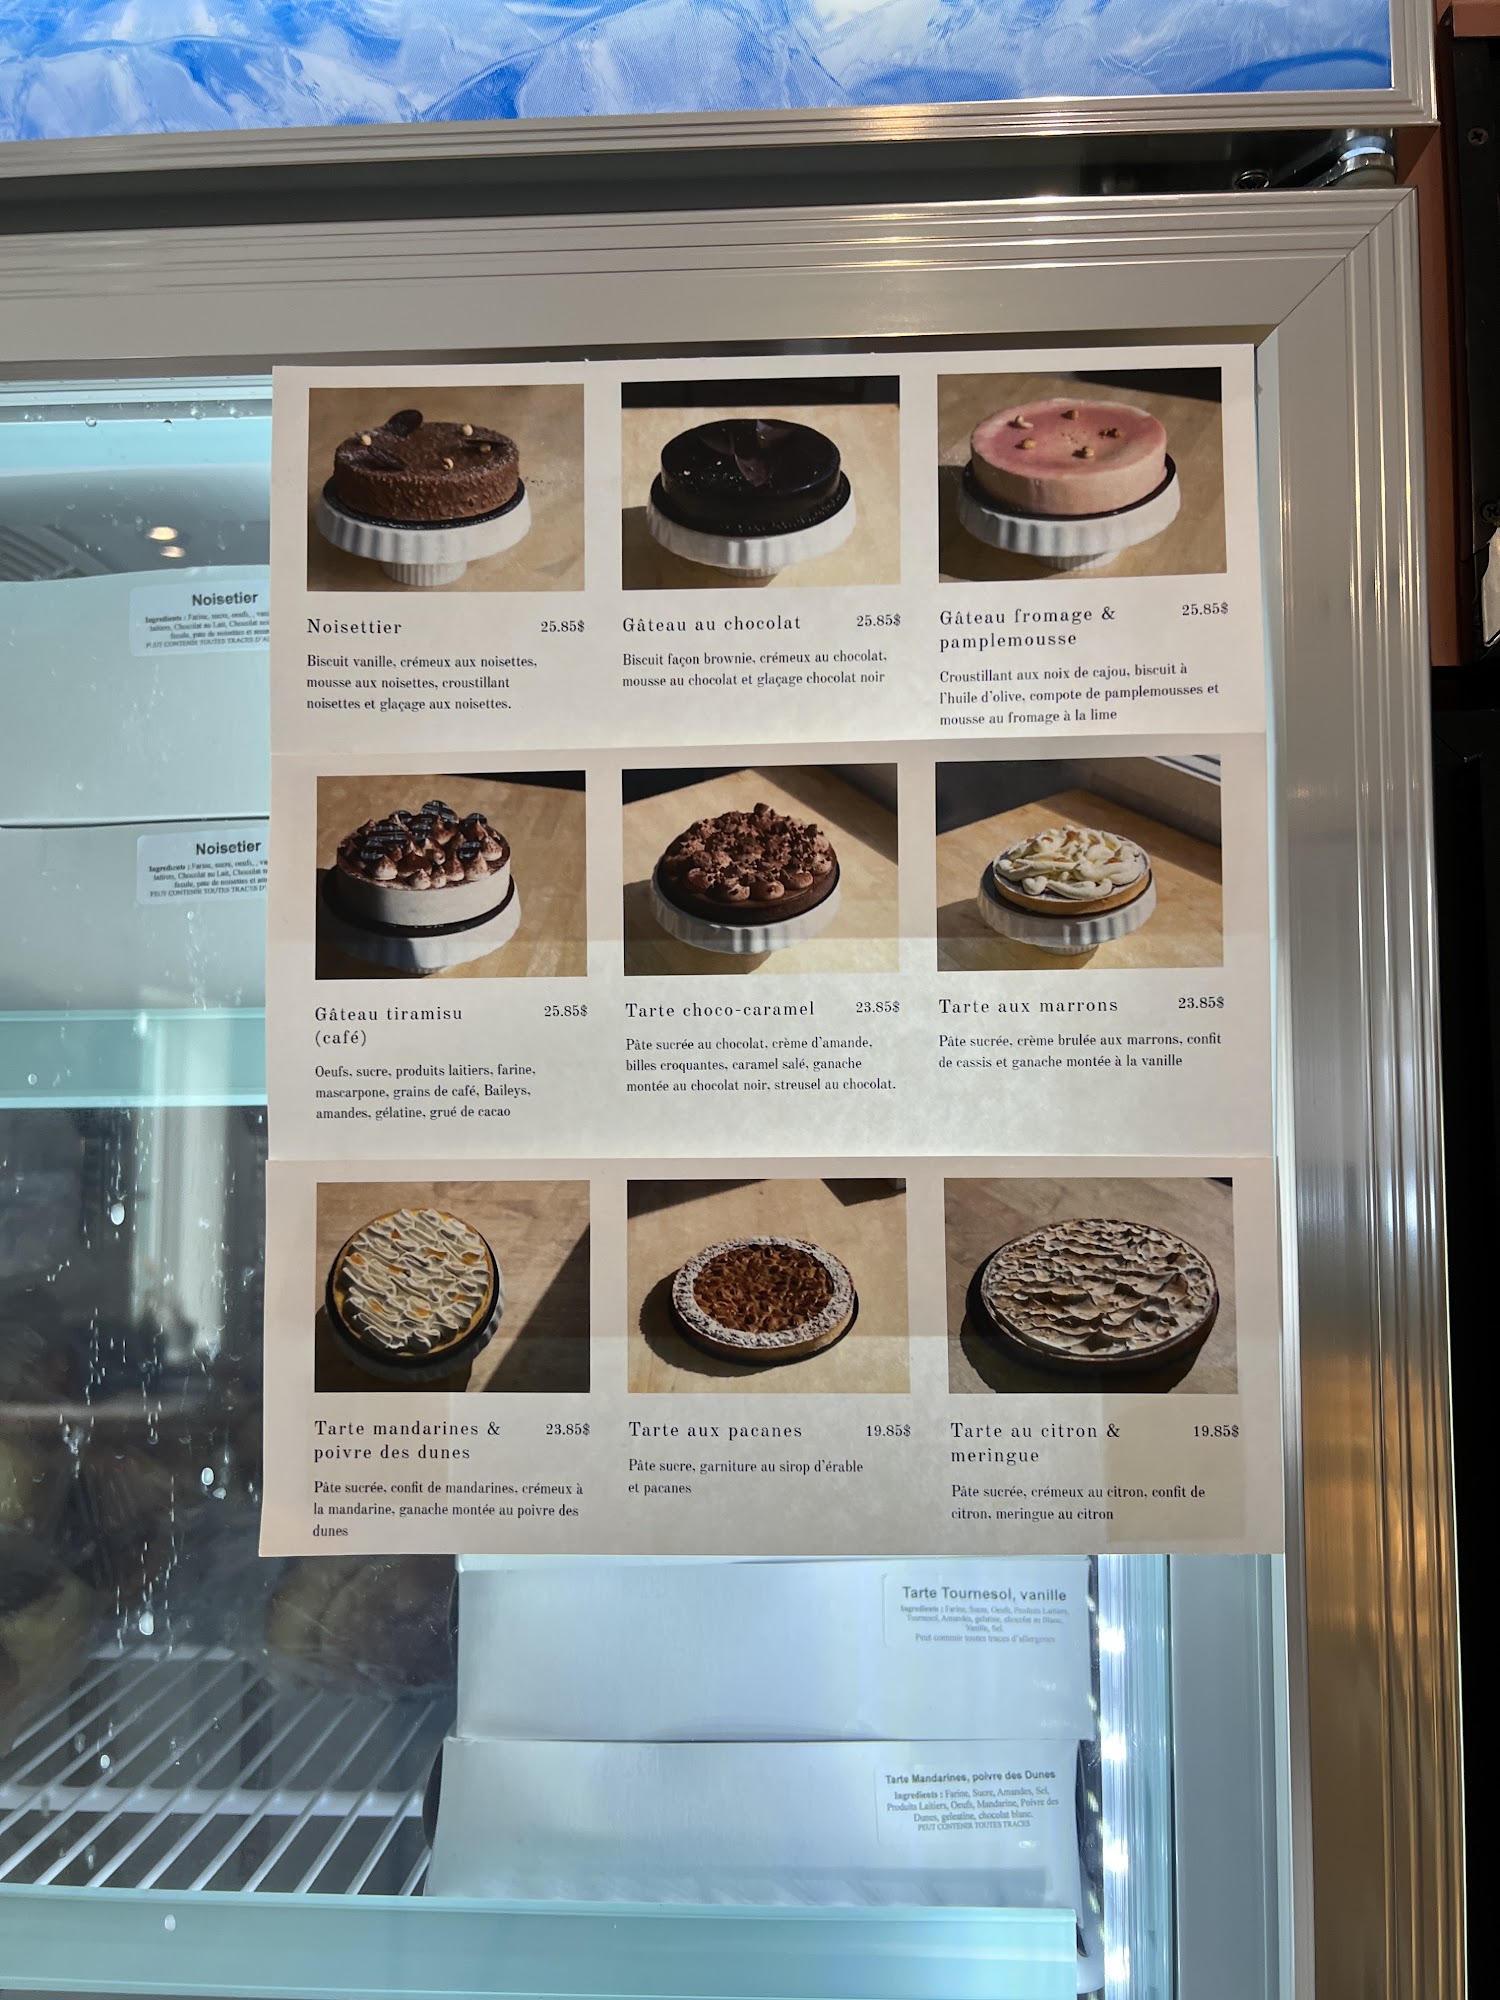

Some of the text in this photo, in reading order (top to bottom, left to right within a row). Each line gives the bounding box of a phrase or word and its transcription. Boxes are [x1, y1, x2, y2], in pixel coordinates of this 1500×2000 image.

[192, 592, 259, 606] Noisetier
[939, 605, 1116, 625] Gâteau fromage &
[1181, 601, 1229, 615] 25.85$
[307, 618, 402, 633] Noisettier
[540, 619, 585, 632] 25.85$
[622, 614, 801, 632] Gâteau au chocolat
[856, 612, 901, 626] 25.85$
[940, 632, 1077, 652] pamplemousse
[307, 653, 538, 667] Biscuit vanille, crémeux aux noisettes,
[622, 648, 887, 667] Biscuit façon brownie, crémeux au chocolat,
[939, 662, 1188, 682] Croustillant aux noix de cajou, biscuit à
[306, 675, 510, 689] mousse aux noisettes, croustillant
[1029, 689, 1083, 703] compote
[1085, 686, 1101, 699] de
[1104, 684, 1204, 701] pamplemousses
[1207, 683, 1219, 693] et
[195, 841, 262, 855] Noisetier
[625, 1000, 814, 1017] Tarte choco-caramel
[855, 1000, 900, 1013] 23.85$
[938, 998, 1118, 1013] Tarte aux marrons
[1178, 996, 1225, 1008] 23.85$
[314, 1006, 462, 1021] Gâteau tiramisu
[544, 1004, 588, 1016] 25.85$
[315, 1029, 367, 1047] (café)
[625, 1038, 653, 1050] Pâte
[655, 1038, 695, 1049] sucrée
[697, 1041, 712, 1049] au
[715, 1036, 769, 1049] chocolat,
[772, 1037, 808, 1048] crème
[938, 1031, 1222, 1046] Pâte sucrée, crème brulée aux marrons, confit
[314, 1063, 536, 1079] Oeufs, sucre, produits laitiers, farine,
[625, 1056, 863, 1073] billes croquantes, caramel salé, ganache
[315, 1105, 511, 1121] amandes, gélatine, grué de cacao
[314, 1420, 501, 1435] Tarte mandarines &
[545, 1422, 591, 1435] 23.85$
[628, 1421, 802, 1441] Tarte aux pacanes
[867, 1423, 911, 1436] 19.85$
[950, 1422, 1121, 1437] Tarte au citron &
[1194, 1424, 1240, 1437] 19.85$
[314, 1444, 470, 1462] poivre des dunes
[951, 1447, 1039, 1466] meringue
[629, 1458, 656, 1471] Pâte
[659, 1463, 696, 1472] sucre,
[699, 1459, 758, 1474] garniture
[760, 1463, 776, 1472] au
[779, 1460, 811, 1475] sirop
[314, 1480, 584, 1494] Pâte sucrée, confit de mandarines, crémeux à
[628, 1483, 692, 1496] et pacanes
[951, 1484, 1206, 1498] Pâte sucrée, crémeux au citron, confit de
[902, 1585, 1067, 1602] Tarte Tournesol, vanille
[886, 1769, 1057, 1784] Tarte Mandarines, poivre des Dunes
[978, 1810, 1010, 1820] chocolat
[918, 1823, 936, 1831] PEUT
[975, 1821, 1002, 1830] TOUTES
[1003, 1820, 1031, 1829] TRACES
